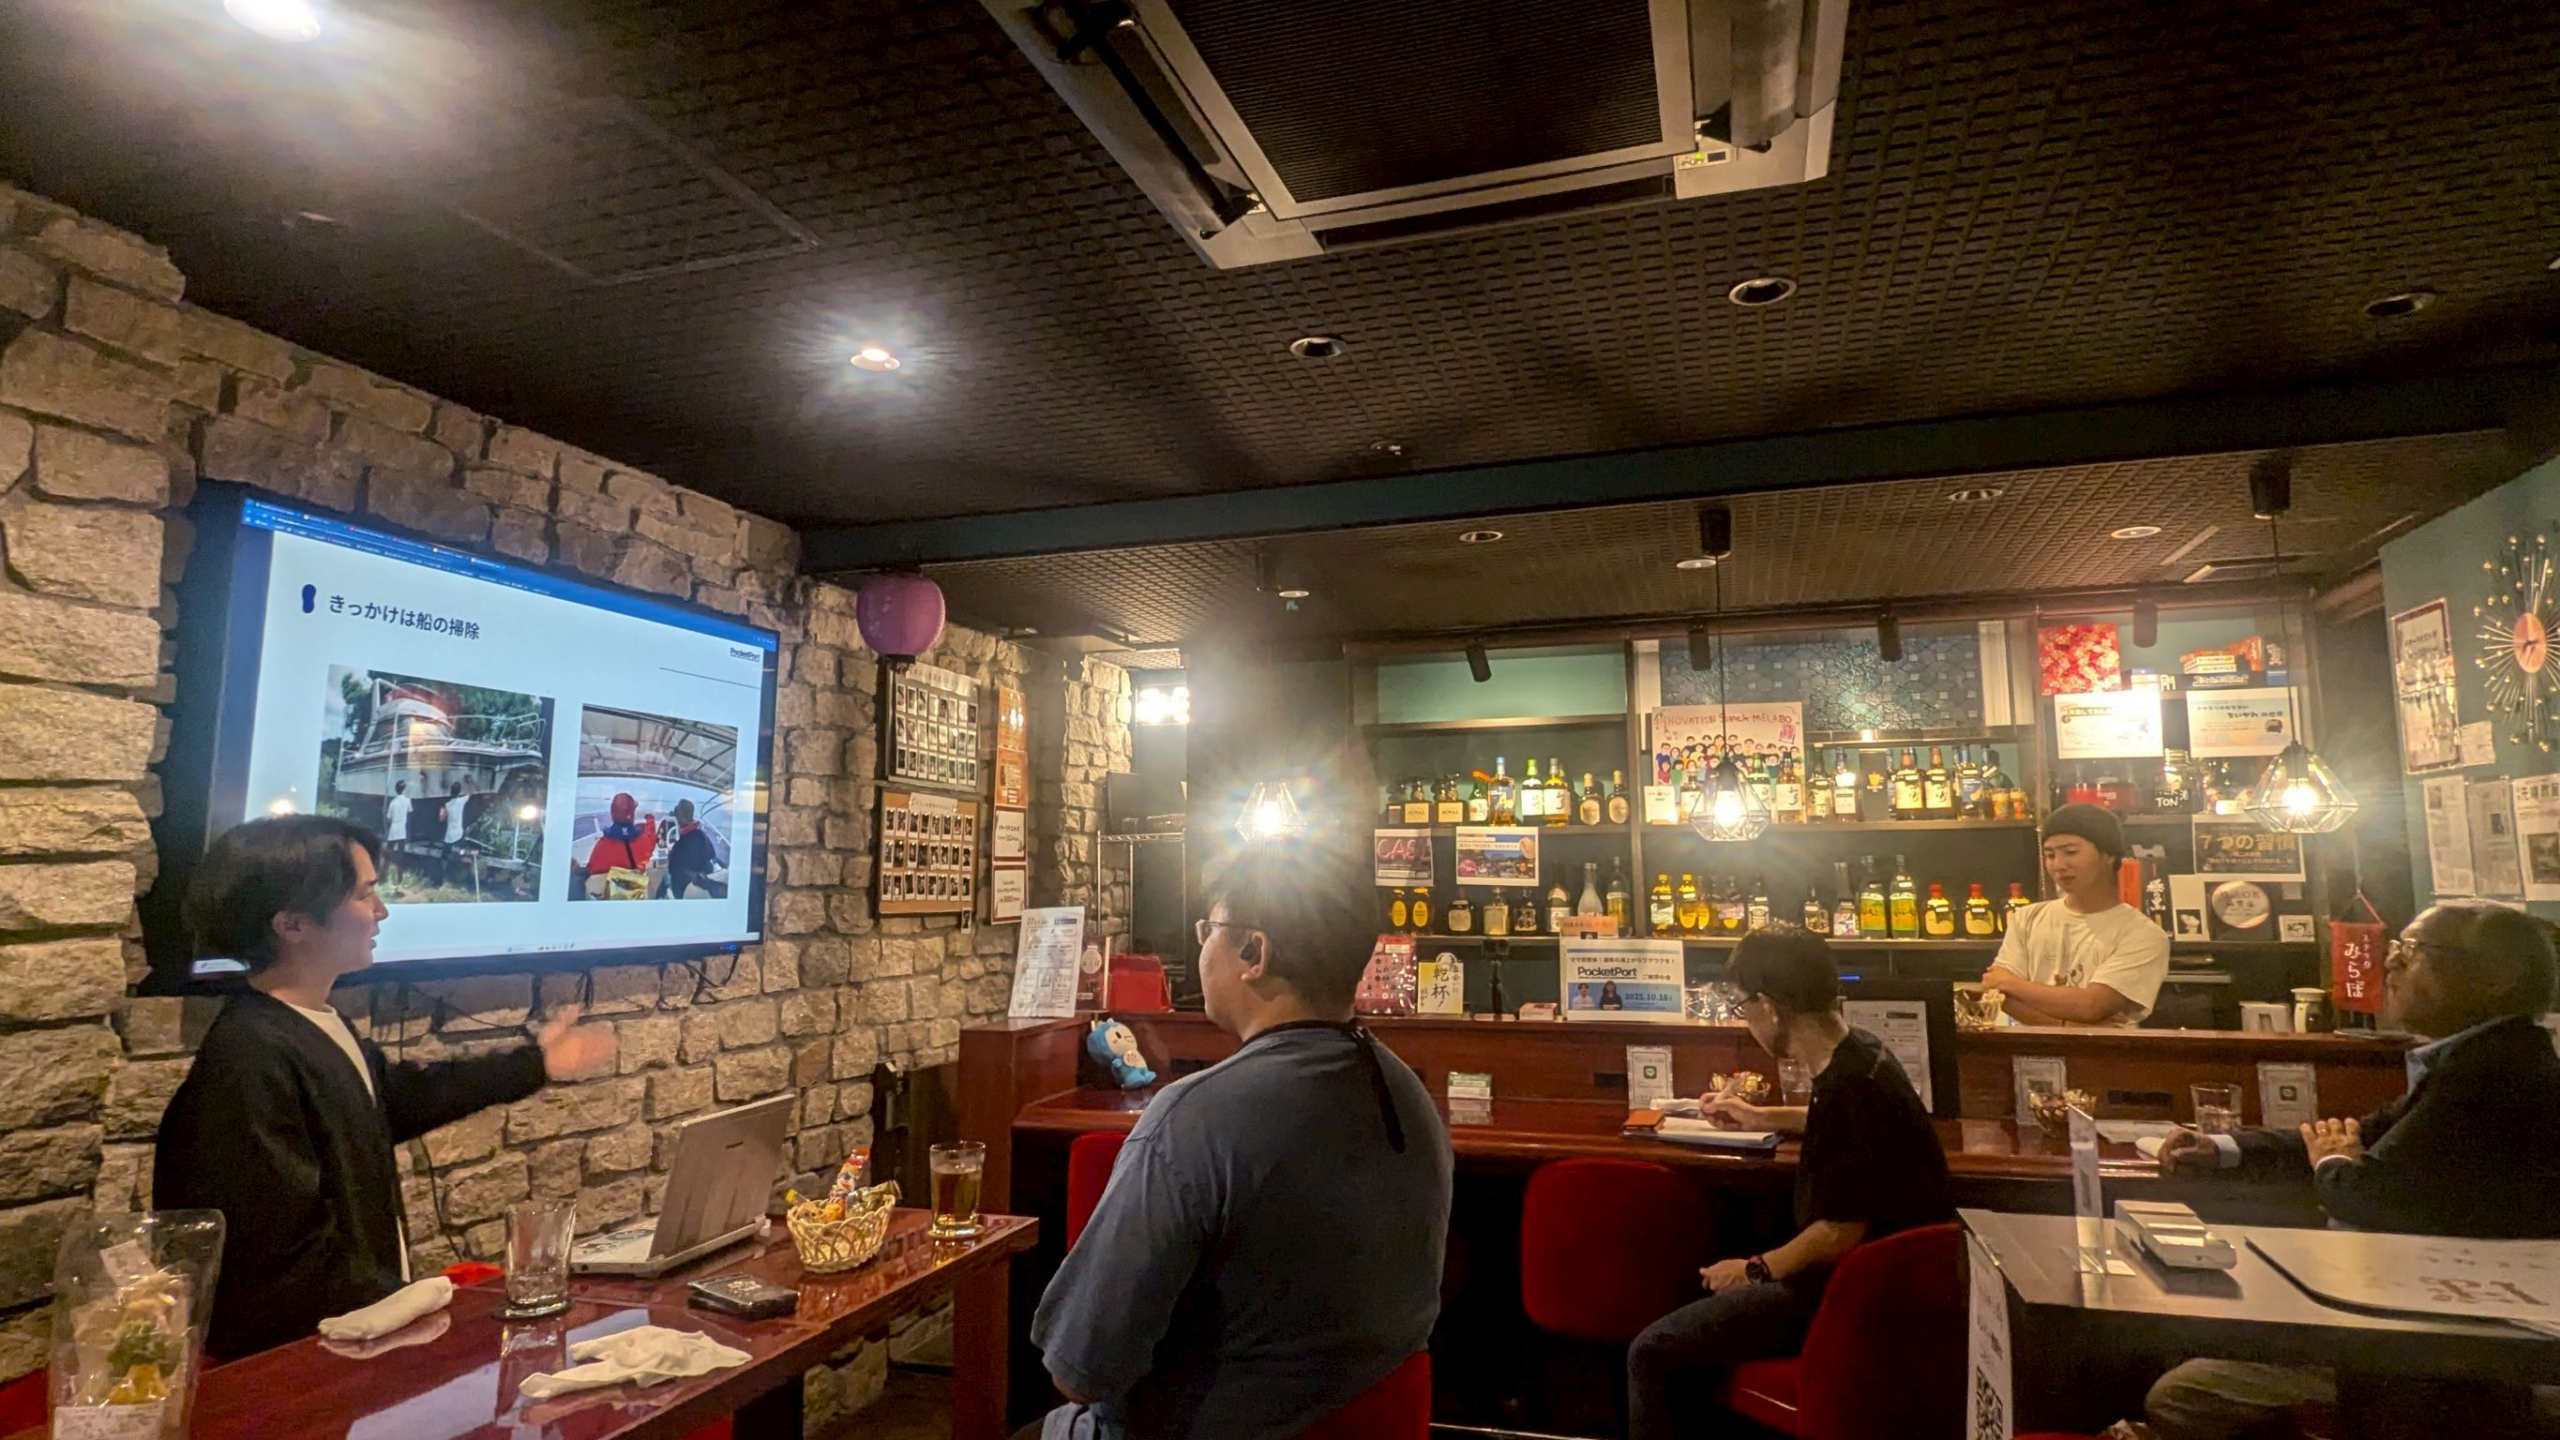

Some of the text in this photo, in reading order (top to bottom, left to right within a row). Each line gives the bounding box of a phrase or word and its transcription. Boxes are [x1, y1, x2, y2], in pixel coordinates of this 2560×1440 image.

[329, 594, 480, 640] きっかけは船の掃除
[1577, 966, 1637, 976] PocketPort
[2344, 942, 2365, 998] みらぼ
